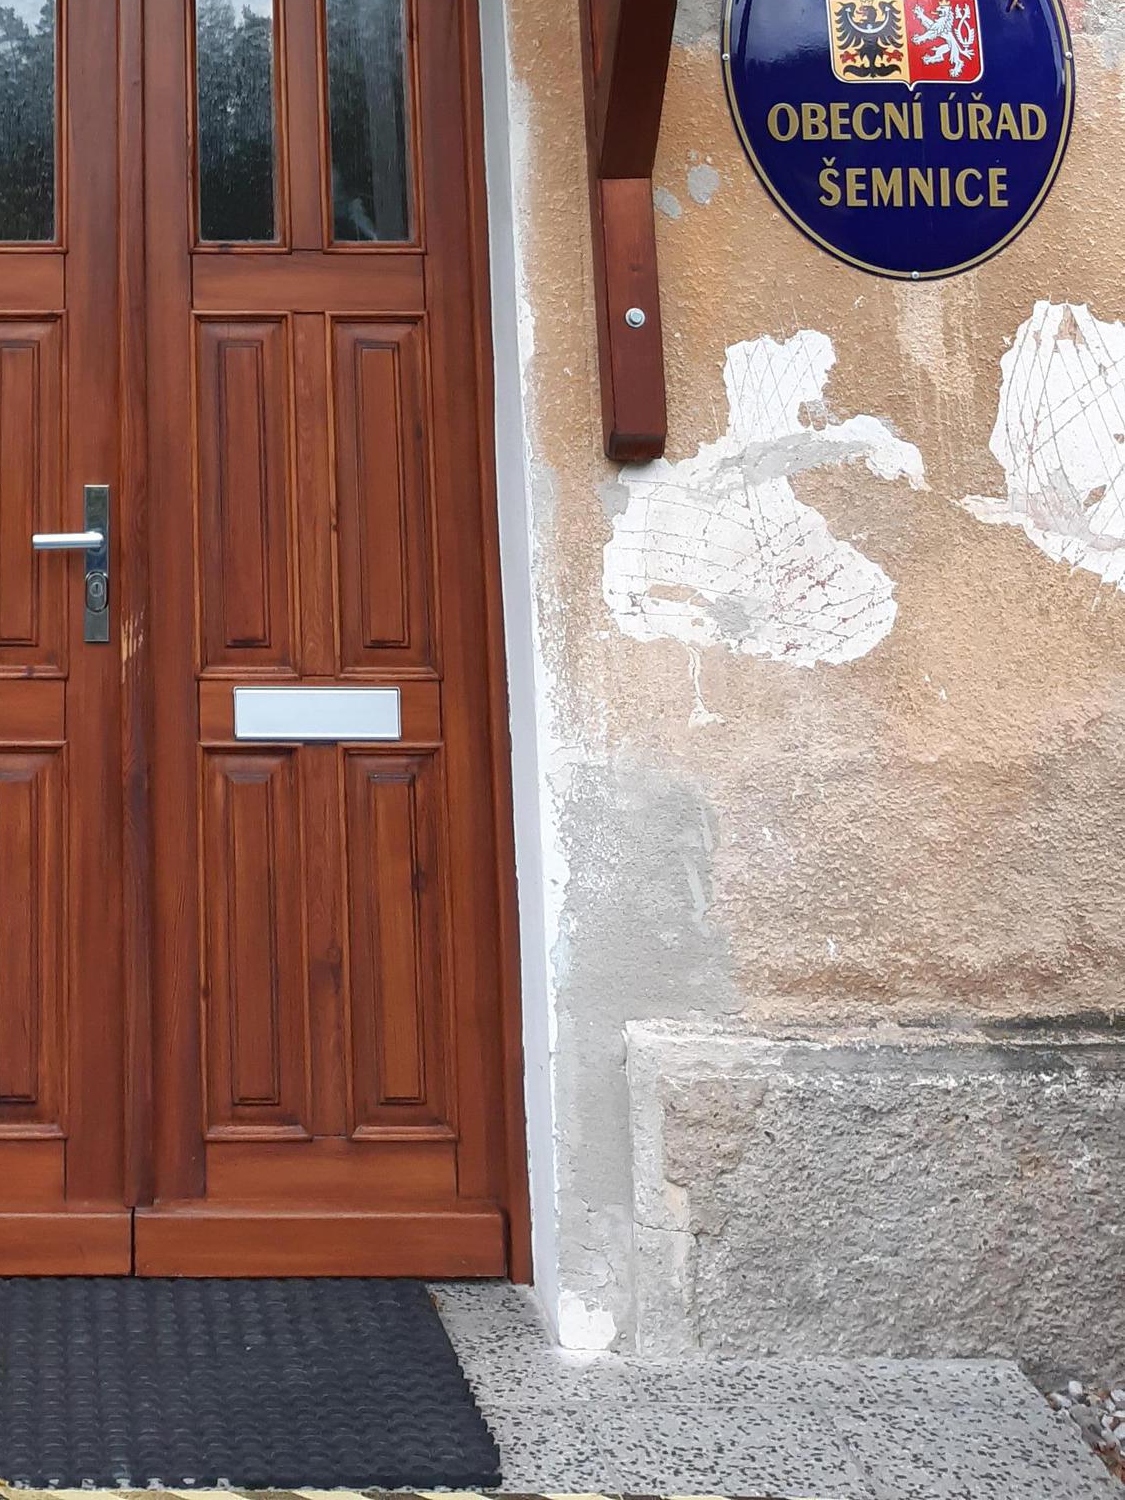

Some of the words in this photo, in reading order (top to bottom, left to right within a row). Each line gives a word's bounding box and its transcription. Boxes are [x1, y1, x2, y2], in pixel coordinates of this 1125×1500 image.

[766, 92, 923, 142] OBECNÍ
[940, 91, 1047, 141] ÚŘAD
[817, 157, 1009, 208] ŠEMNICE
